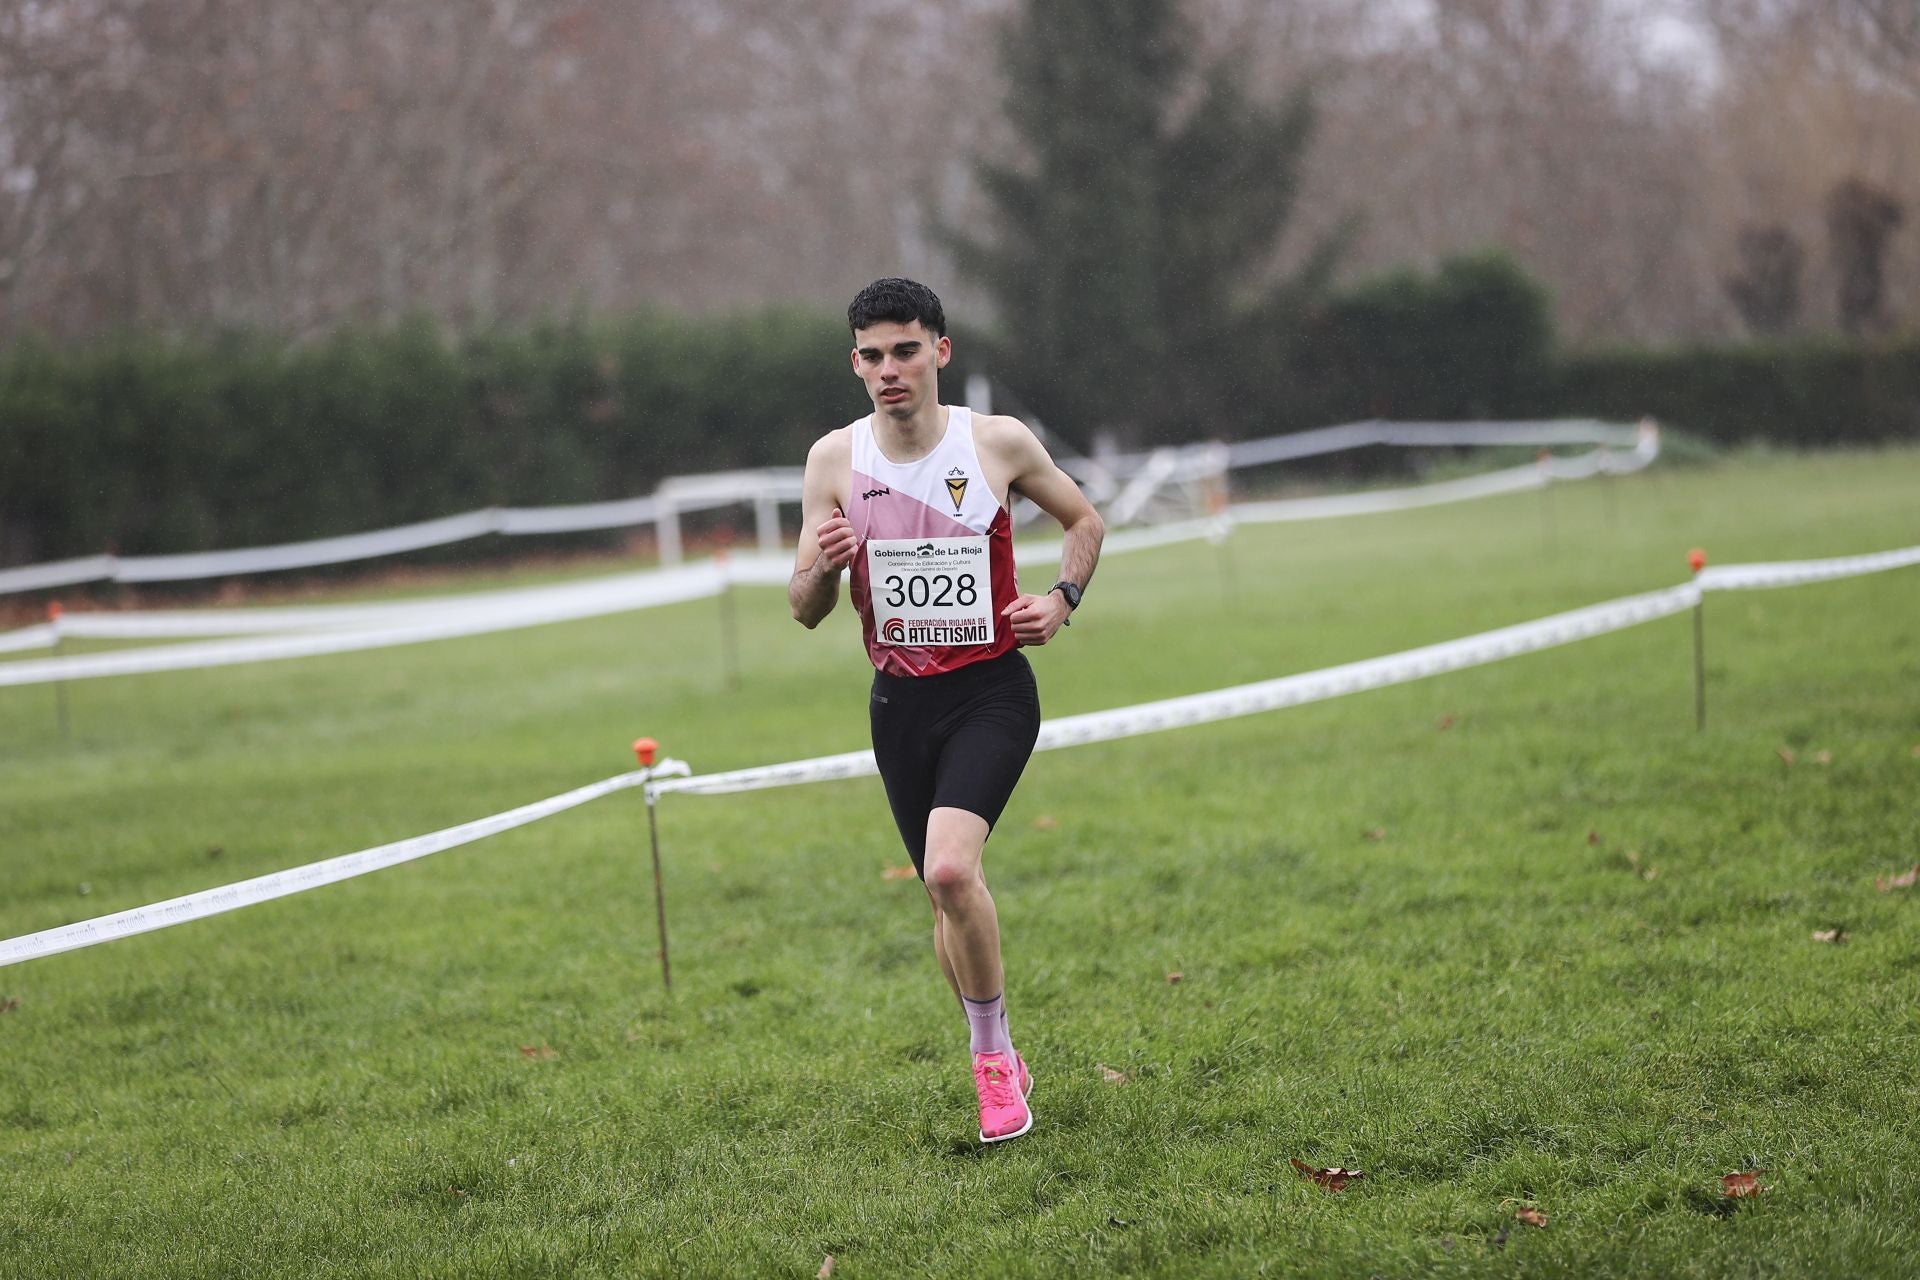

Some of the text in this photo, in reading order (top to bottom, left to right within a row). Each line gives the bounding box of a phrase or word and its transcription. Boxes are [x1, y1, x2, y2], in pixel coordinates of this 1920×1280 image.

[874, 546, 982, 557] Gobierno de La Rioja
[885, 573, 977, 607] 3028
[908, 617, 987, 627] FEDERACIÓN RIOJANA DE
[909, 625, 988, 643] ATLETISMO
